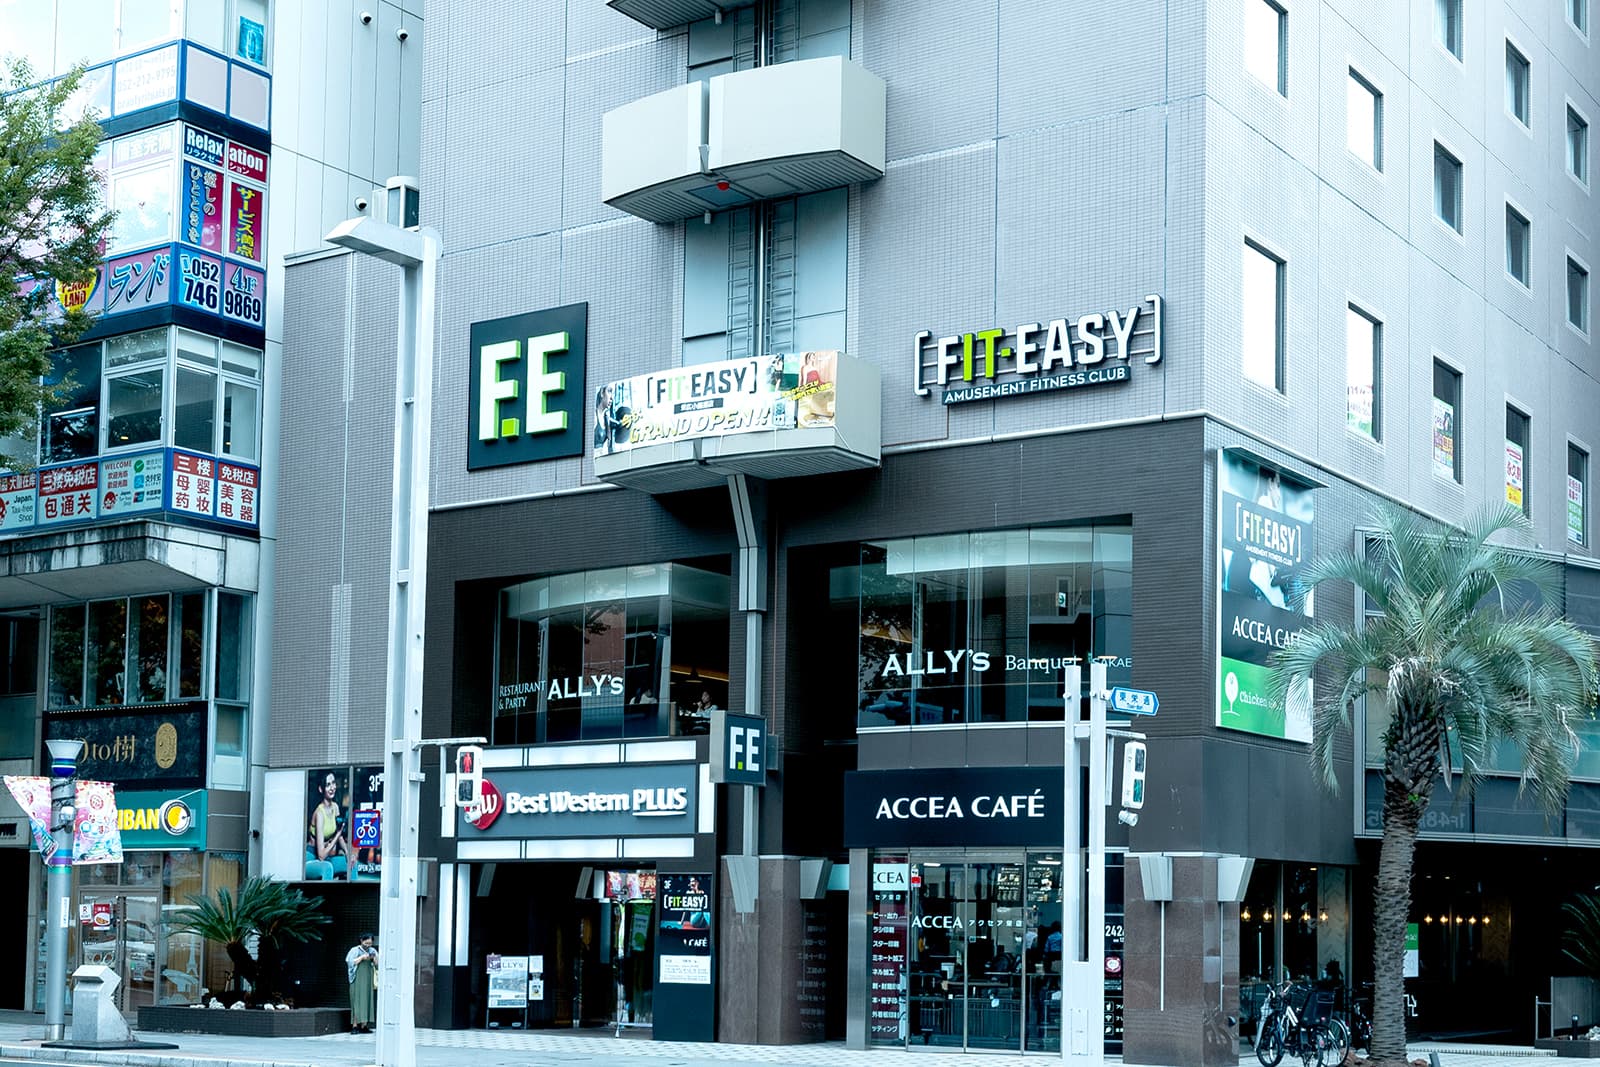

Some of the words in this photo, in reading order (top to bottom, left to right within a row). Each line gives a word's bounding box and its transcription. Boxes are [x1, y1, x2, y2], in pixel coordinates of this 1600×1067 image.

[186, 128, 223, 159] Relax
[229, 151, 263, 173] ation
[192, 258, 219, 283] 052
[231, 266, 257, 296] 4F
[108, 253, 170, 312] ランド
[64, 290, 87, 308] LAND
[183, 278, 218, 310] 746
[224, 291, 262, 323] 9869
[944, 383, 1026, 404] AMUSEMENT
[1030, 374, 1085, 392] FITNESS
[1088, 367, 1126, 384] CLUB
[630, 418, 692, 444] GRAND
[105, 460, 132, 470] WELCOME
[177, 456, 211, 477] 三楼
[222, 466, 254, 485] 免税店
[176, 475, 210, 496] 母婴
[220, 484, 253, 505] 美容
[14, 495, 33, 504] Japan
[45, 492, 91, 519] 包通关
[176, 491, 210, 513] 药妆
[18, 513, 33, 522] Shop
[220, 501, 253, 522] 电器
[1232, 616, 1273, 646] ACCEA
[499, 702, 504, 710] &
[506, 792, 549, 815] Best
[550, 791, 630, 814] Western
[632, 788, 687, 812] PLUS
[876, 797, 964, 819] ACCEA
[971, 789, 1045, 818] CAFÉ
[911, 915, 963, 929] ACCEA
